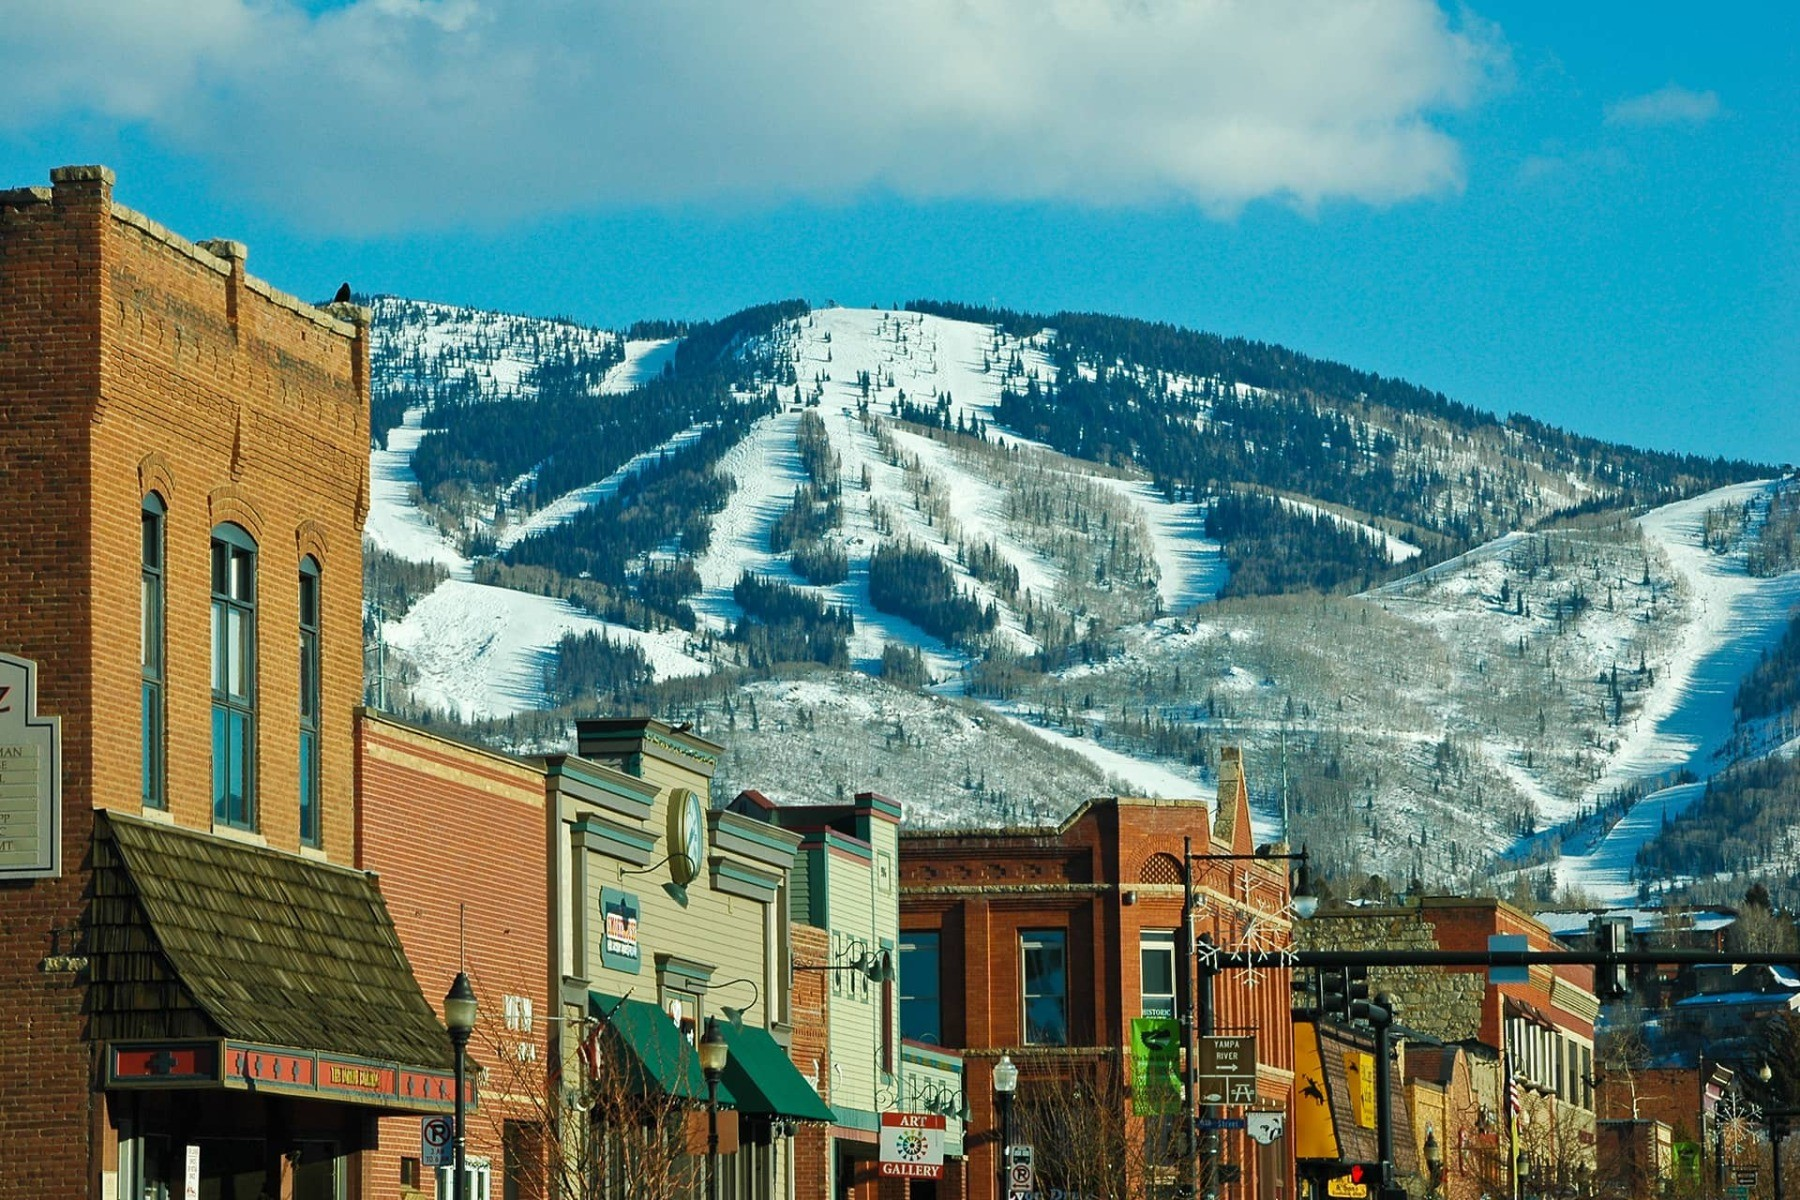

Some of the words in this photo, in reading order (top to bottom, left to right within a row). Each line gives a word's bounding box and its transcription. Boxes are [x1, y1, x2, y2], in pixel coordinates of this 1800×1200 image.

[1142, 1008, 1171, 1016] HISTORIC
[1214, 1040, 1240, 1049] YAMPA
[1216, 1052, 1238, 1060] RIVER
[900, 1115, 928, 1127] ART
[882, 1163, 940, 1177] GALLERY
